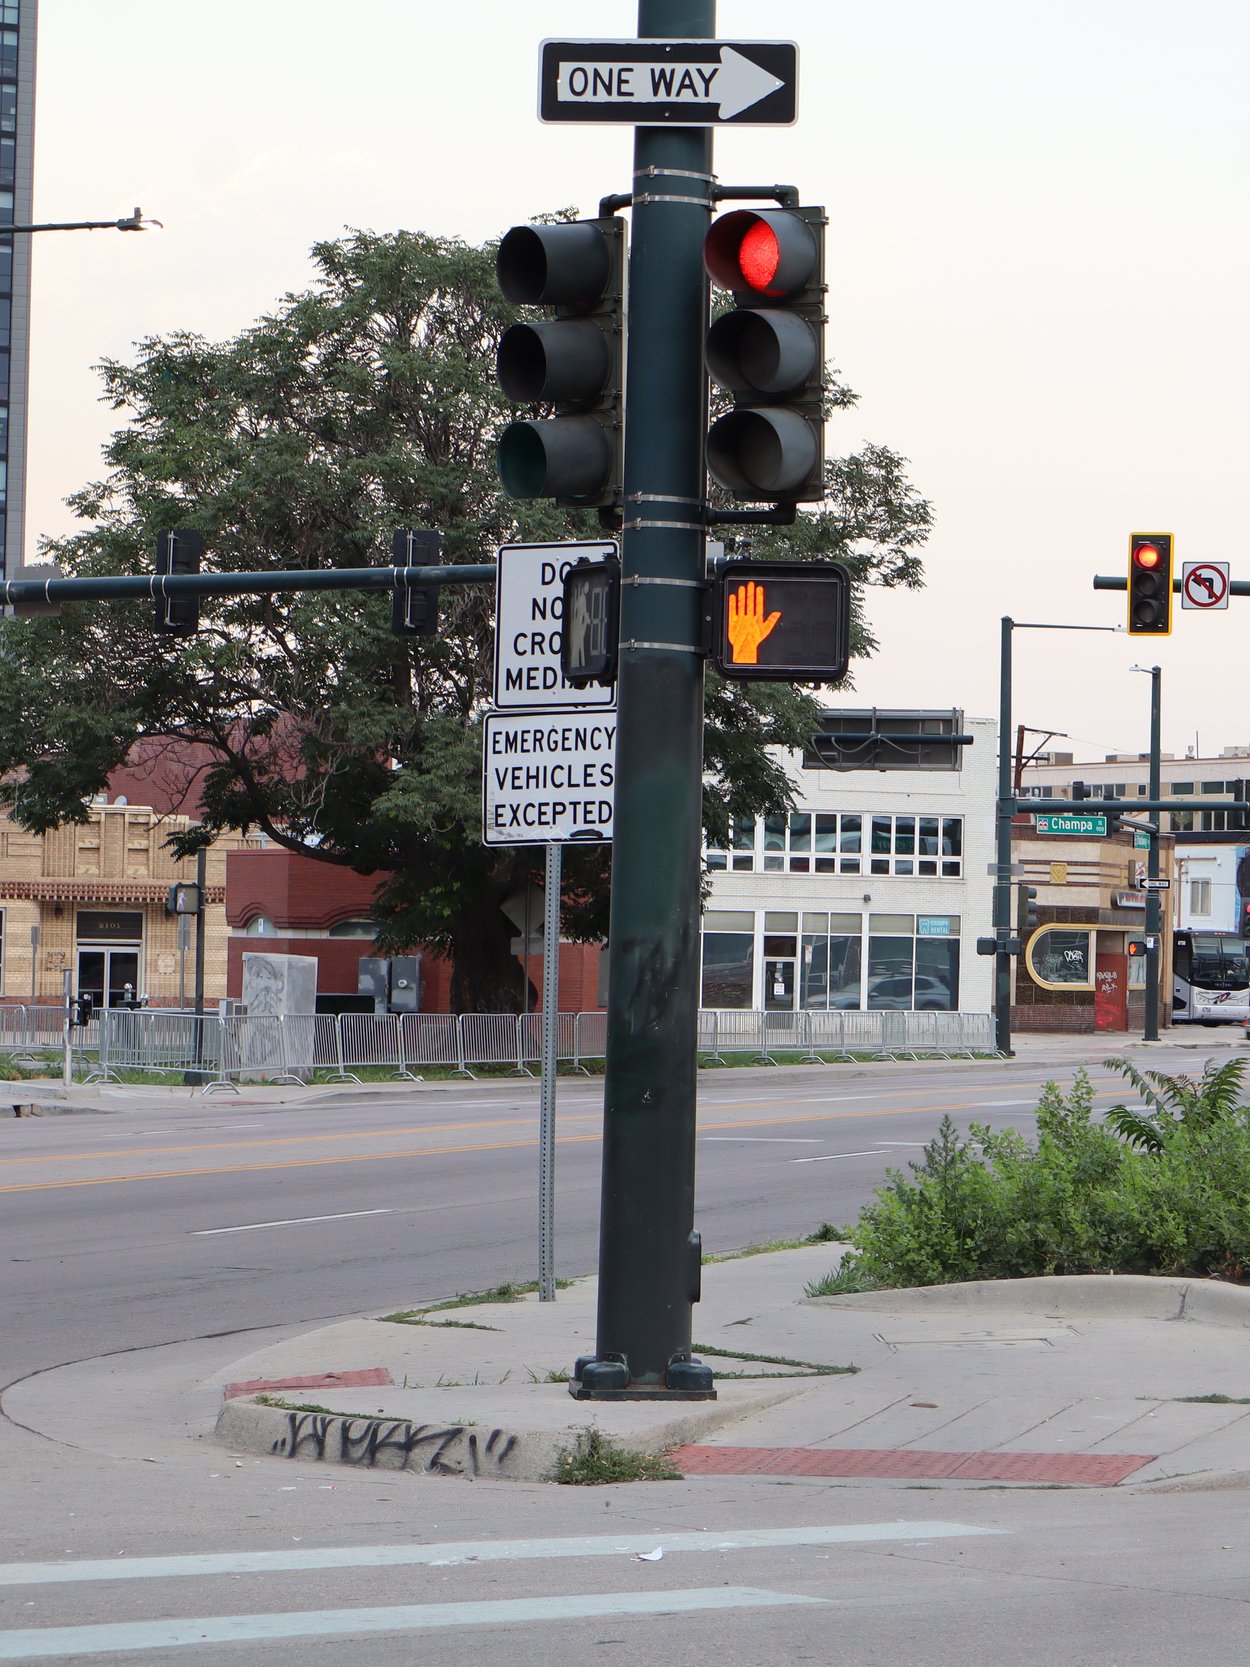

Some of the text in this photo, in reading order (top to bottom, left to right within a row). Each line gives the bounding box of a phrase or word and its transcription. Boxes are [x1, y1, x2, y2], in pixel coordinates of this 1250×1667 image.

[569, 67, 719, 97] ONE WAY
[531, 596, 564, 621] NO
[513, 632, 562, 656] CRO
[492, 726, 617, 755] EMERGENCY
[495, 763, 614, 790] VEHICLES
[494, 800, 613, 827] EXCEPTED
[1051, 817, 1092, 832] Champa
